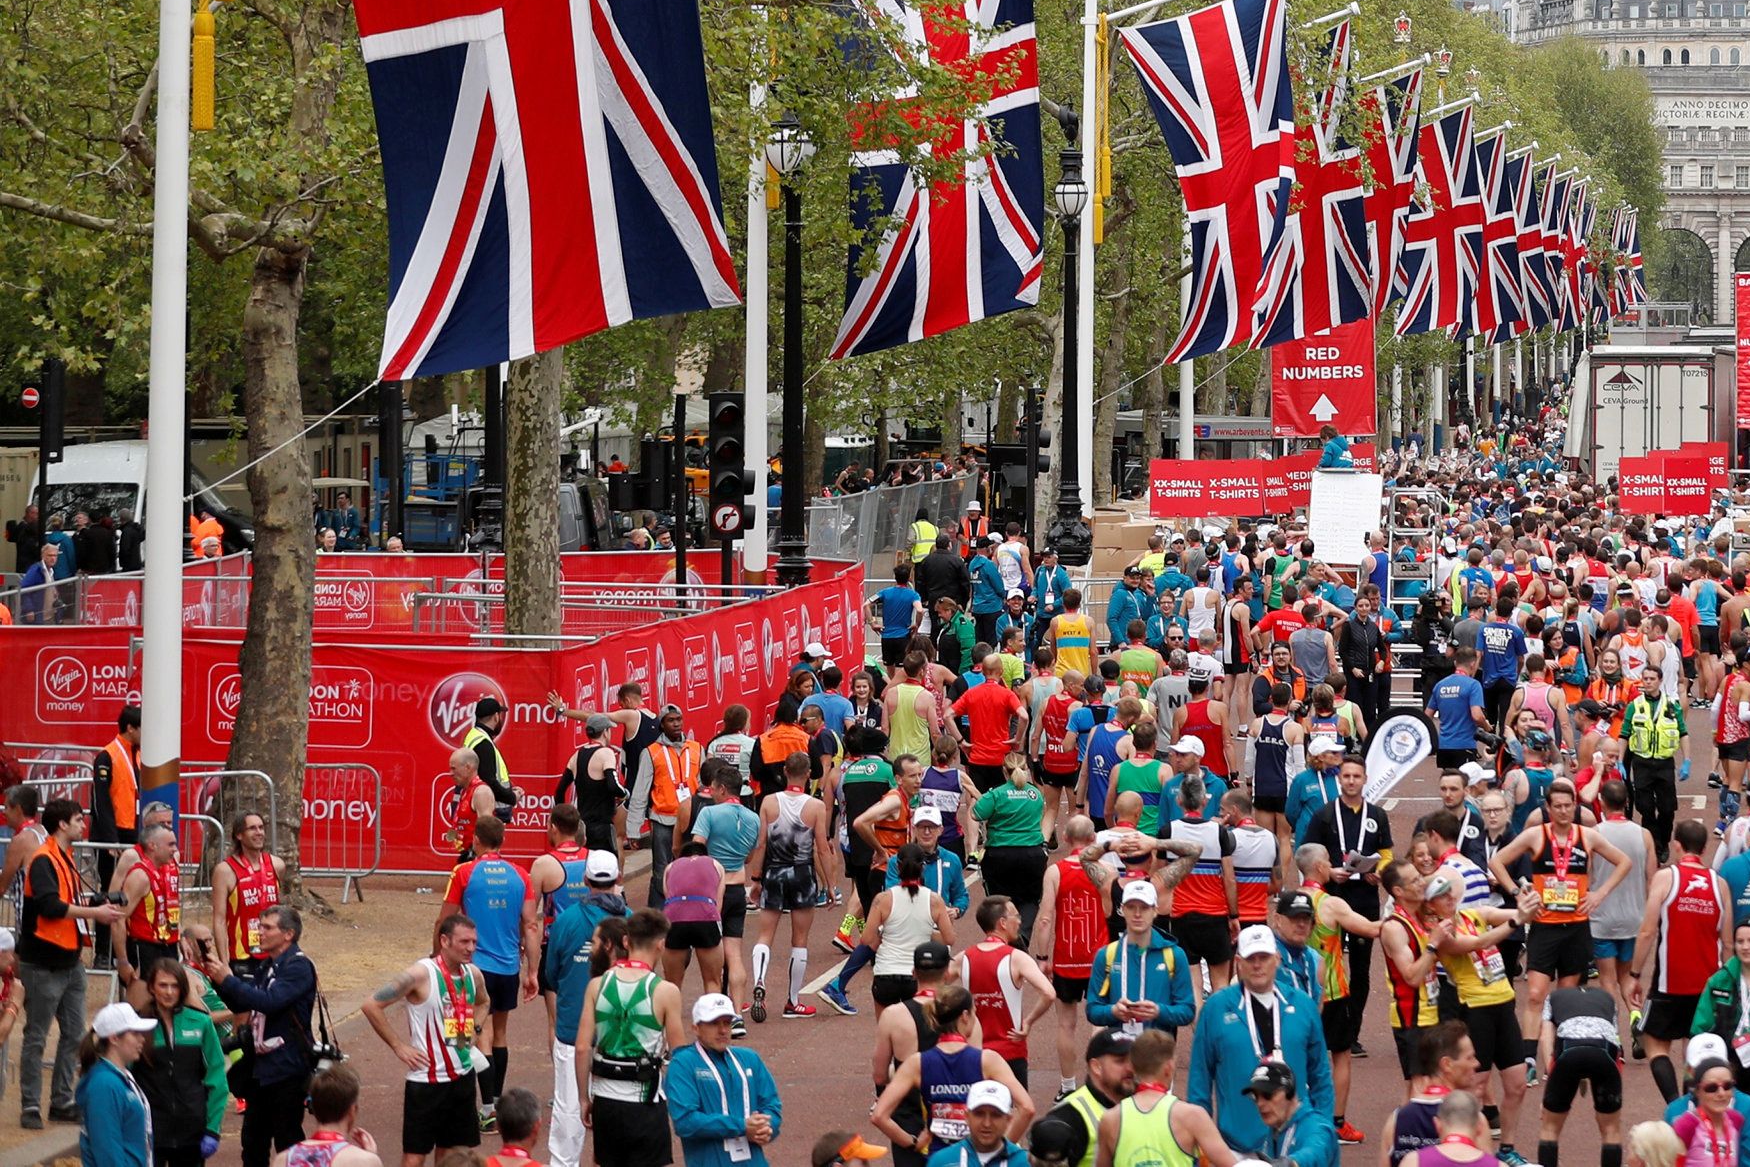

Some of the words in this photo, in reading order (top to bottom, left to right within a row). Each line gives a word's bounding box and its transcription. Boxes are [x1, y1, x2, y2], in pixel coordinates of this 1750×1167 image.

[1672, 101, 1703, 109] ANNO
[1709, 101, 1748, 109] DECIMO
[1305, 347, 1340, 360] RED
[1282, 365, 1364, 380] NUMBERS
[1602, 383, 1640, 391] CEVA
[1353, 458, 1372, 466] RGE
[1287, 471, 1312, 481] MEDI
[1622, 475, 1664, 484] X-SMAL
[1154, 480, 1204, 489] XX-SMALL
[1209, 477, 1259, 487] X-SMALL
[1266, 477, 1284, 486] SMALL
[1666, 478, 1708, 486] XX-SMALL
[1156, 489, 1201, 498] T-SHIRTS
[1209, 489, 1260, 499] T-SHIRTS
[1264, 488, 1288, 497] T-SHIRTS
[1623, 487, 1664, 496] T-SHIRT
[1668, 487, 1706, 496] T-SHIRTS
[1483, 626, 1513, 640] SAMUEL'S
[92, 665, 127, 679] LON
[50, 663, 82, 693] Virgin
[308, 685, 340, 699] DON
[46, 700, 85, 713] money
[307, 702, 363, 717] ATHON
[437, 681, 495, 738] Virg
[516, 795, 557, 809] NDO
[505, 812, 551, 827] ARAT
[1678, 897, 1714, 906] NORFOLK
[1677, 904, 1715, 914] GAZELLES
[930, 1084, 972, 1095] LONDON
